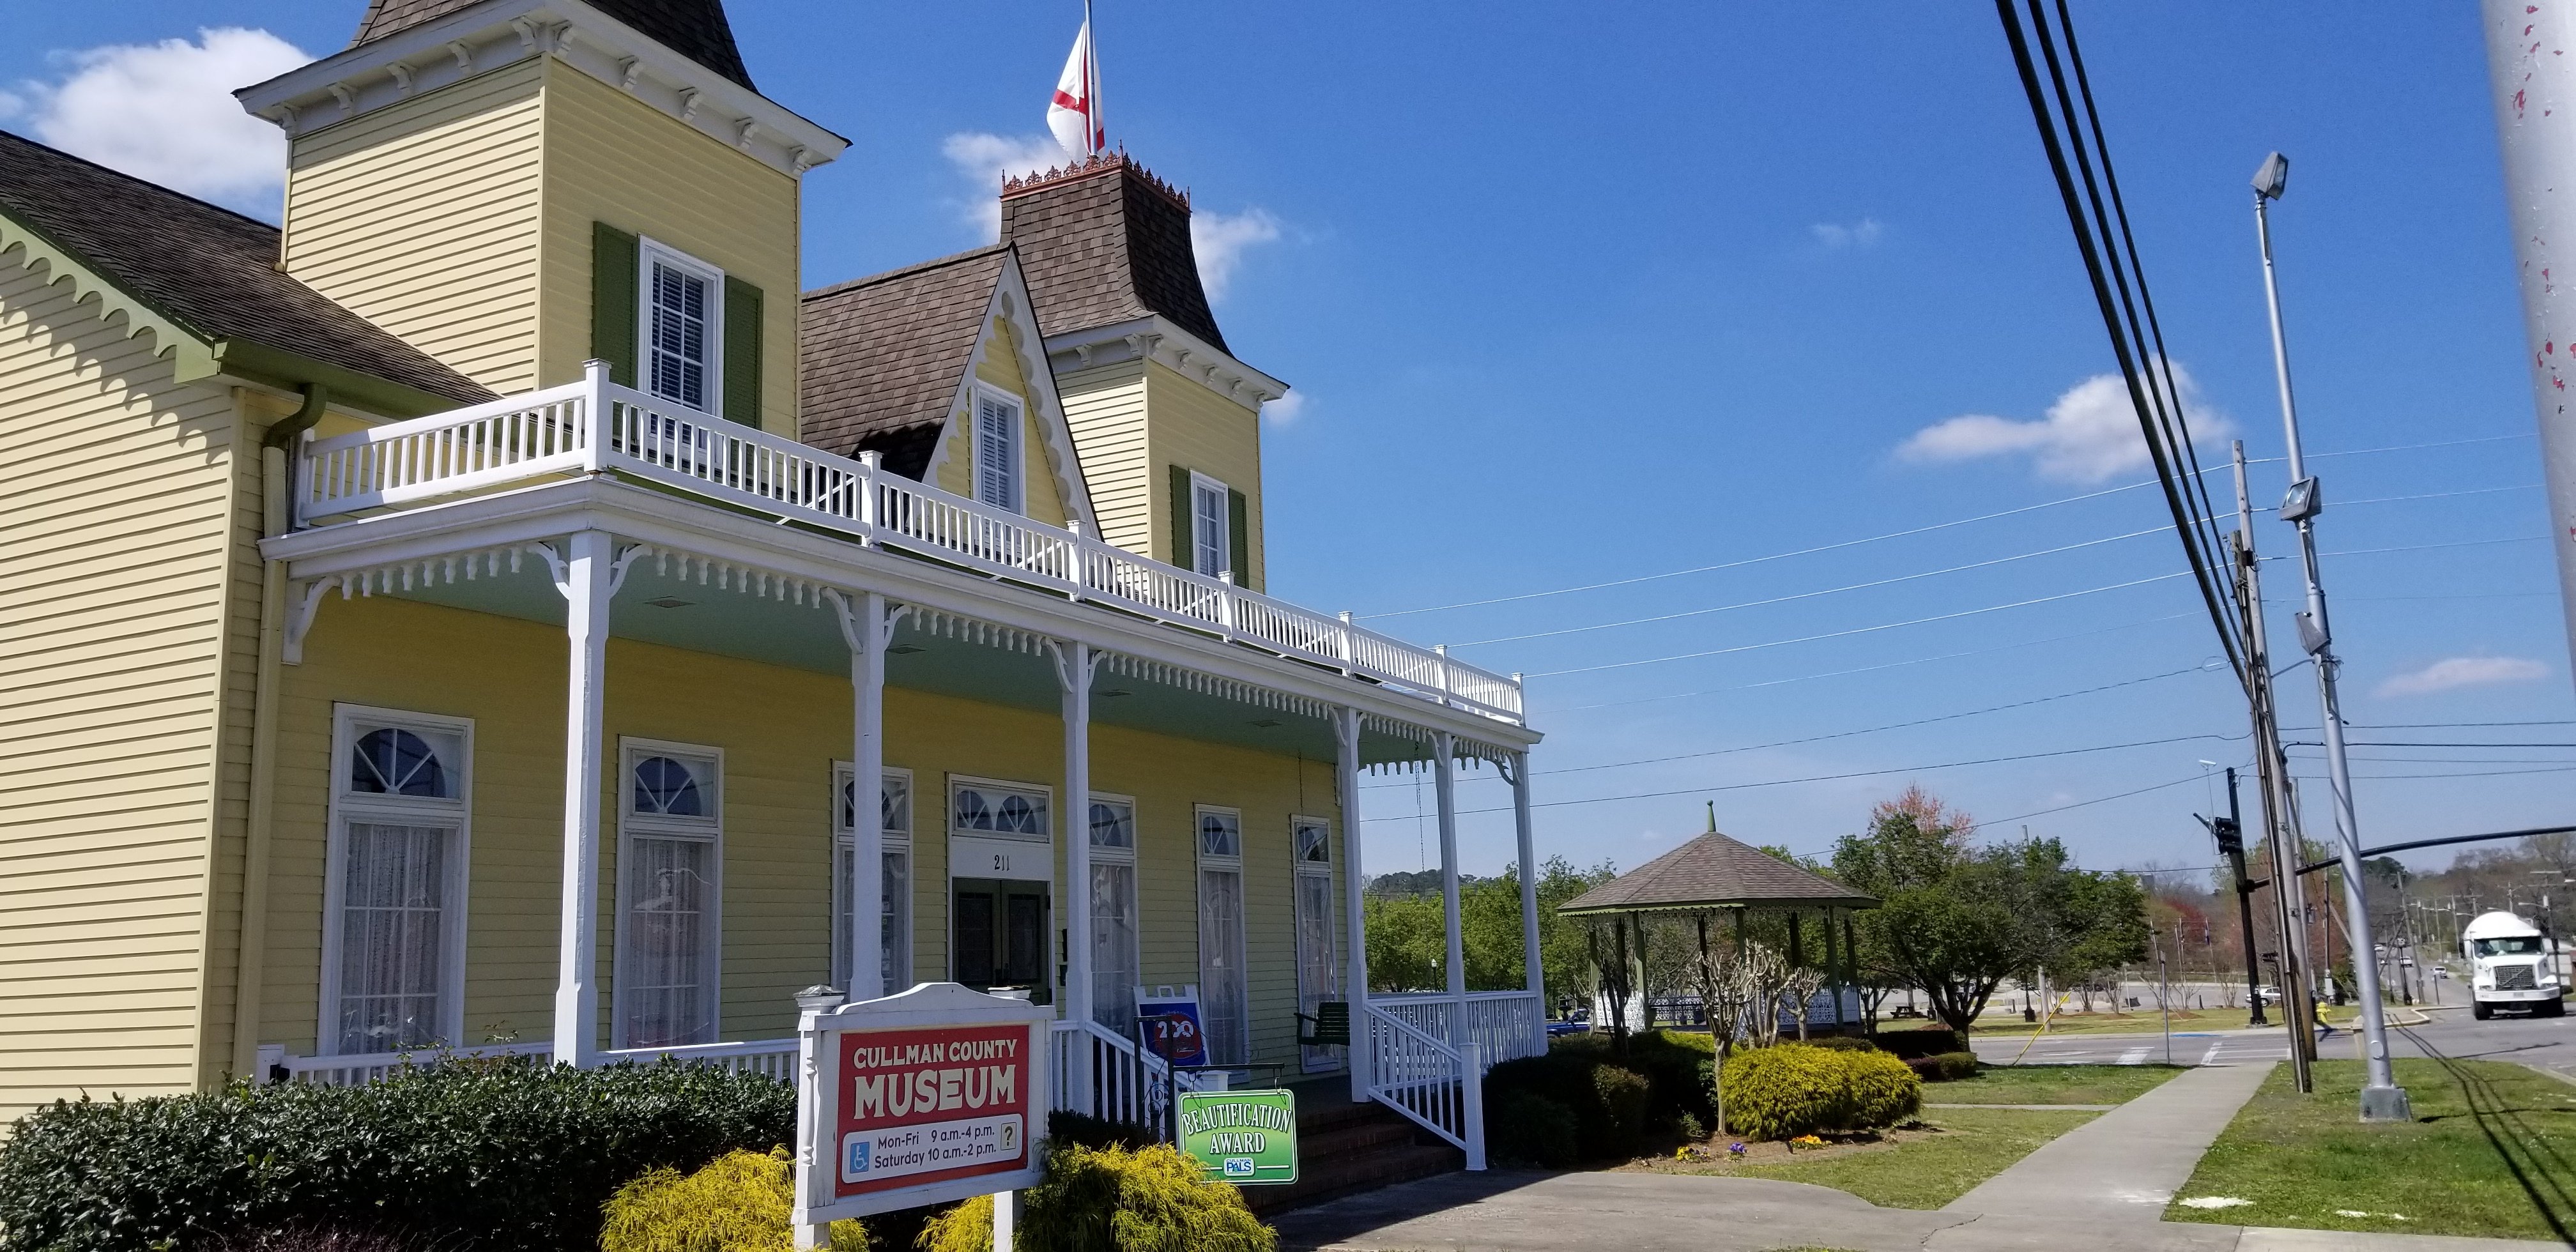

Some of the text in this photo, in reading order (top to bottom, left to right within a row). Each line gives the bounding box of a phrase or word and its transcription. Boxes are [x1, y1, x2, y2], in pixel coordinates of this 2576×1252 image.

[995, 855, 1009, 871] 211
[854, 1039, 1018, 1069] CULLMAN COUNTY
[853, 1064, 1016, 1120] MUSEUM
[1181, 1103, 1292, 1136] BEAUTIFICATION
[878, 1126, 995, 1149] Mon-Fri 9 a.m.-4 p.m.
[1209, 1132, 1265, 1154] AWARD
[875, 1142, 997, 1169] Saturday 10 a.m.-2 p.m.
[1227, 1162, 1252, 1172] PALS
